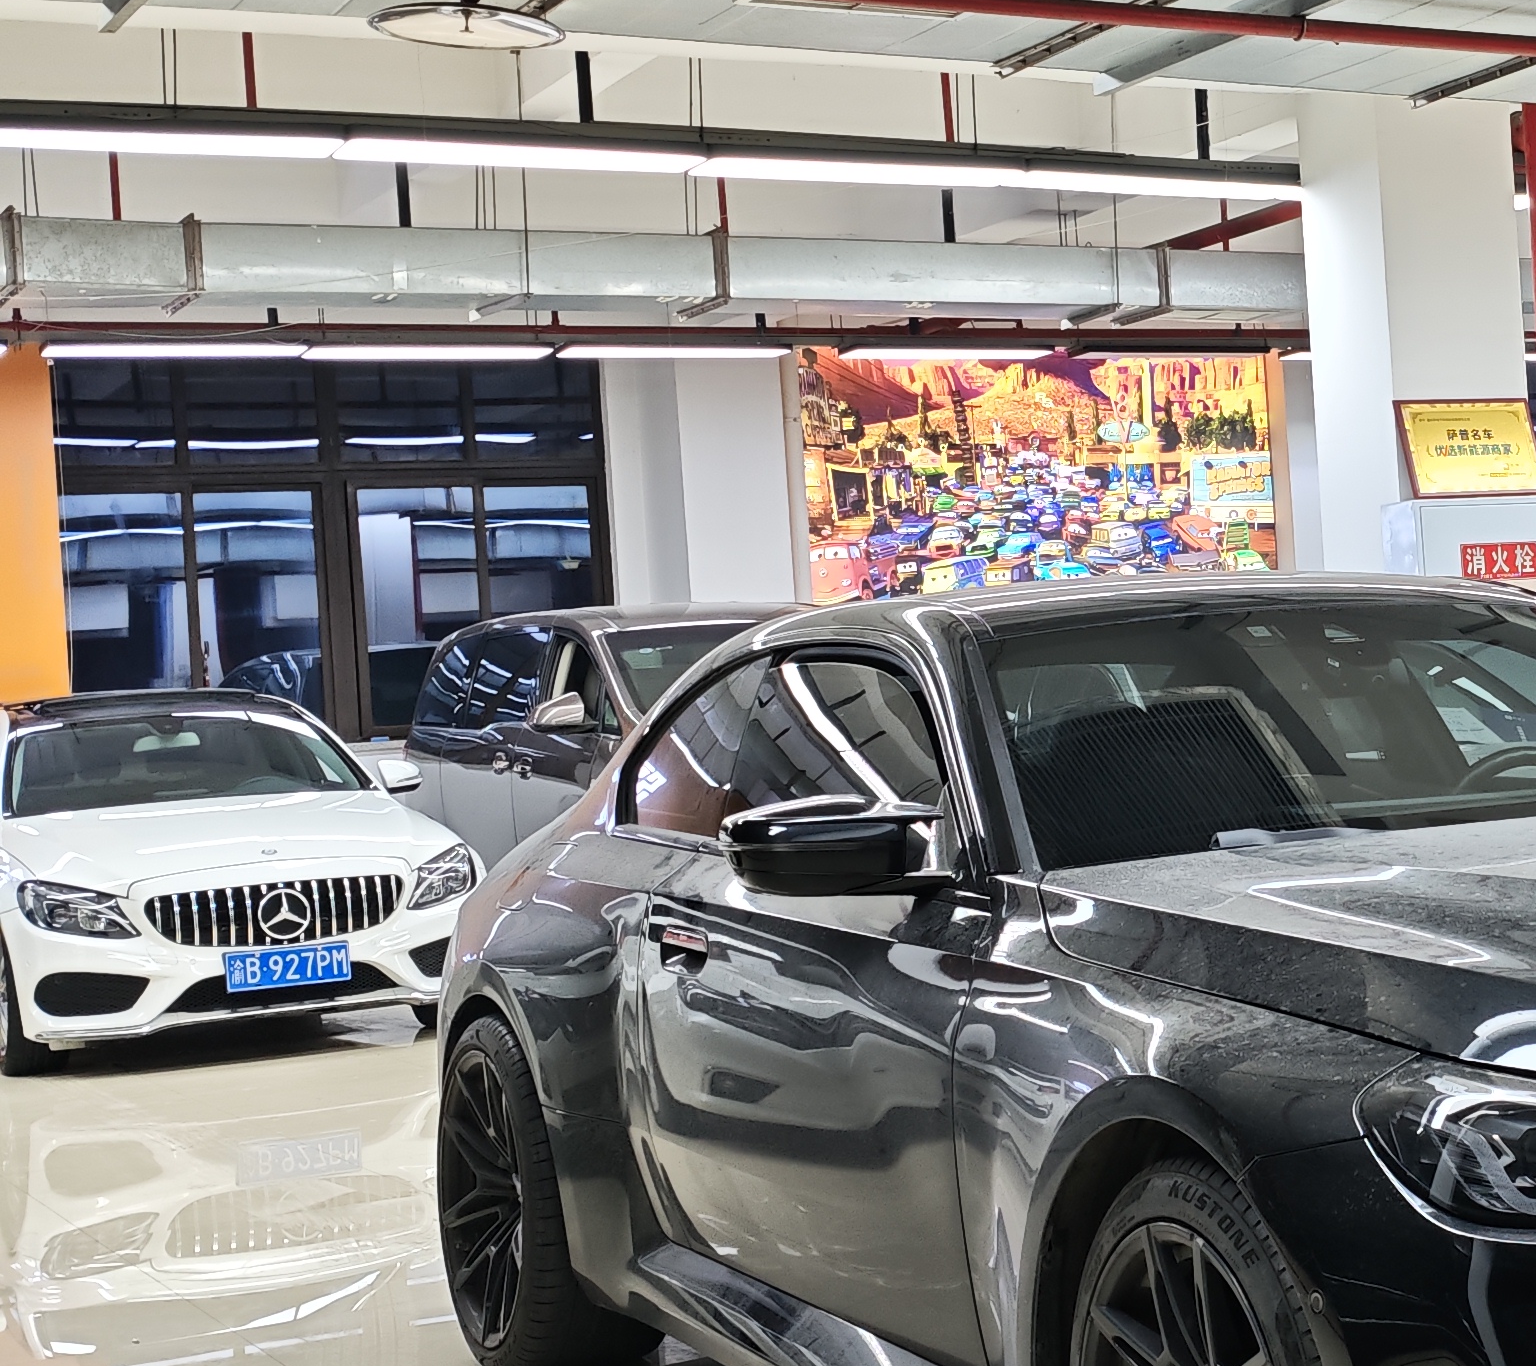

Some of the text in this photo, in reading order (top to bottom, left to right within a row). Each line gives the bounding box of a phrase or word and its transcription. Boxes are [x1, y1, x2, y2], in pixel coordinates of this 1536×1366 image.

[1446, 427, 1495, 442] 萨普名车
[1465, 544, 1536, 575] 消火栓
[1167, 1179, 1261, 1270] KUSTONE
